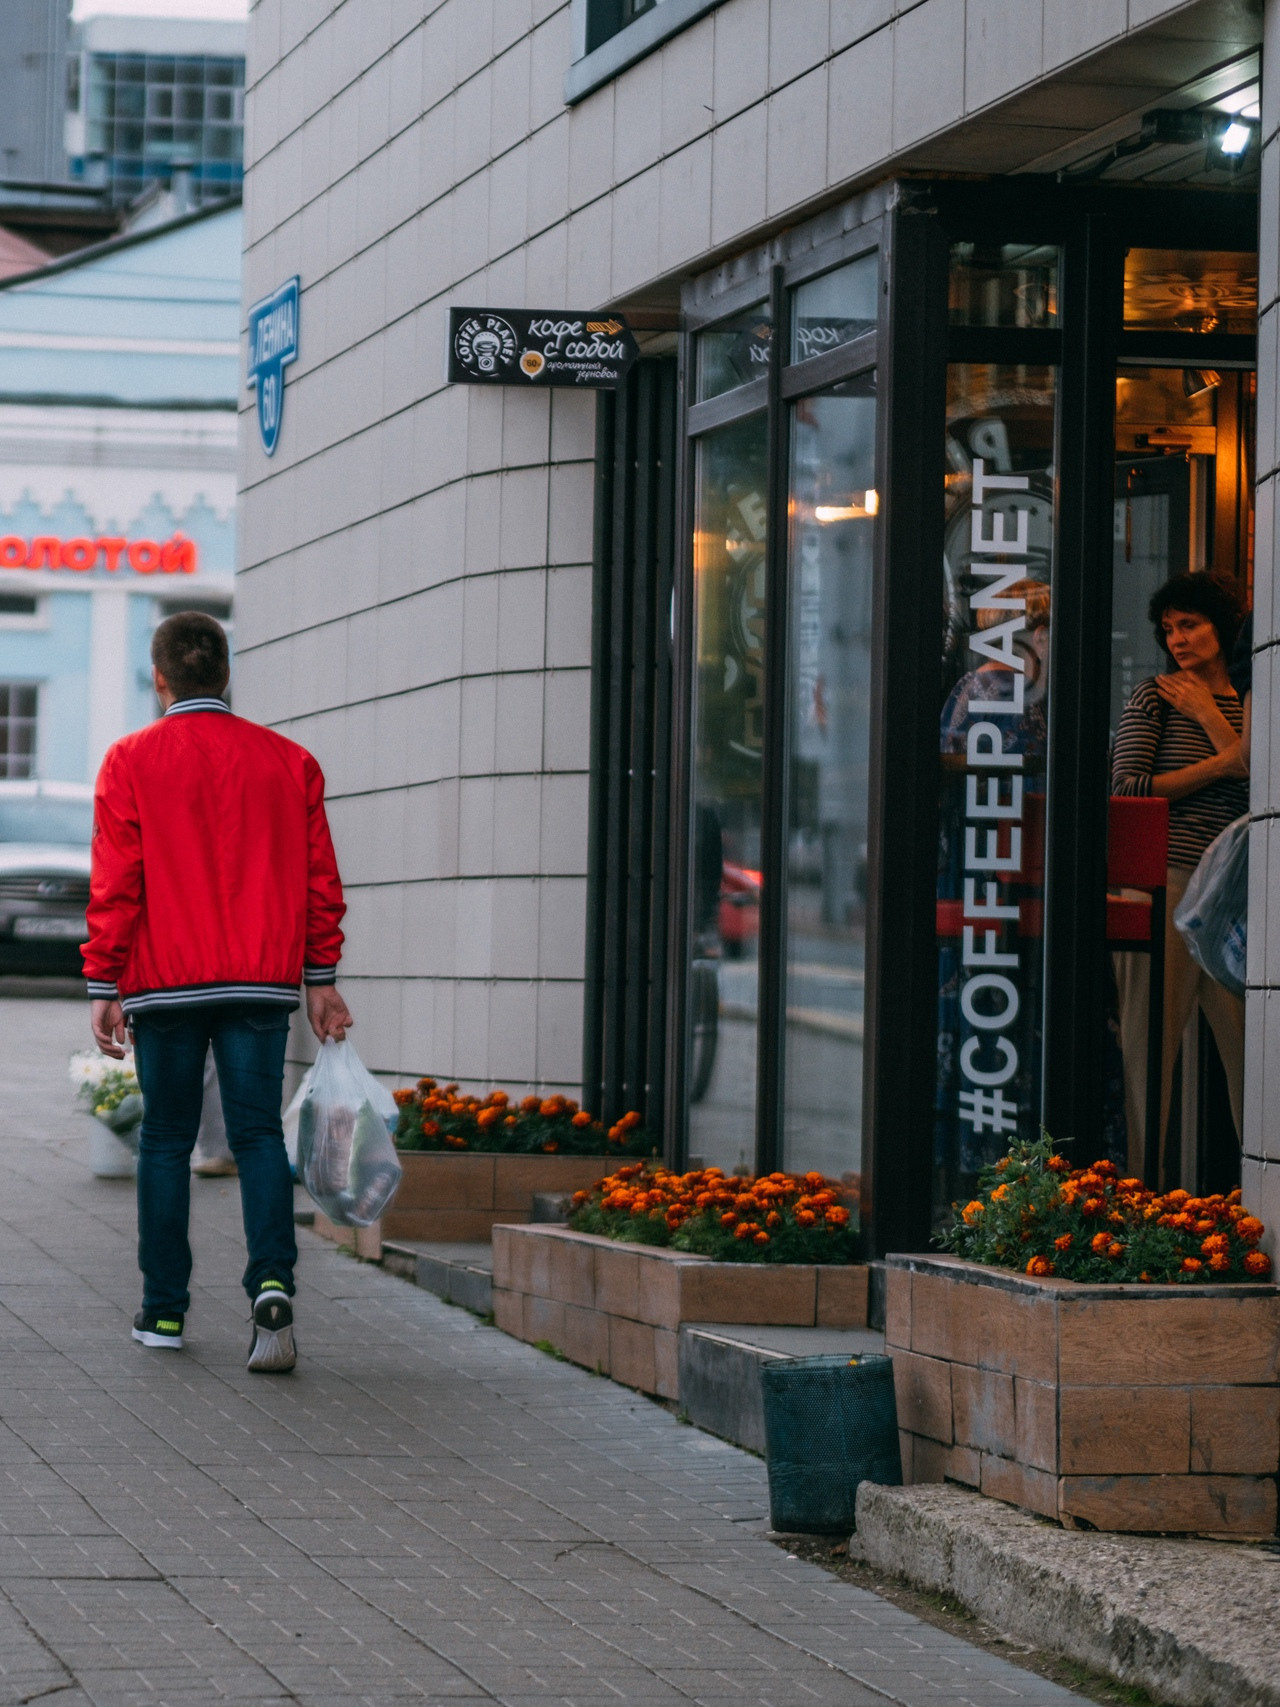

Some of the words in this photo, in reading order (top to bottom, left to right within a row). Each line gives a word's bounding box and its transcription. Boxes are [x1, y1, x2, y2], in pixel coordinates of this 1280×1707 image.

[459, 320, 480, 362] COFFEE
[486, 318, 514, 364] PLANET
[544, 341, 558, 357] с
[565, 332, 624, 359] собой
[959, 458, 1030, 1133] #COFFEEPLANET
